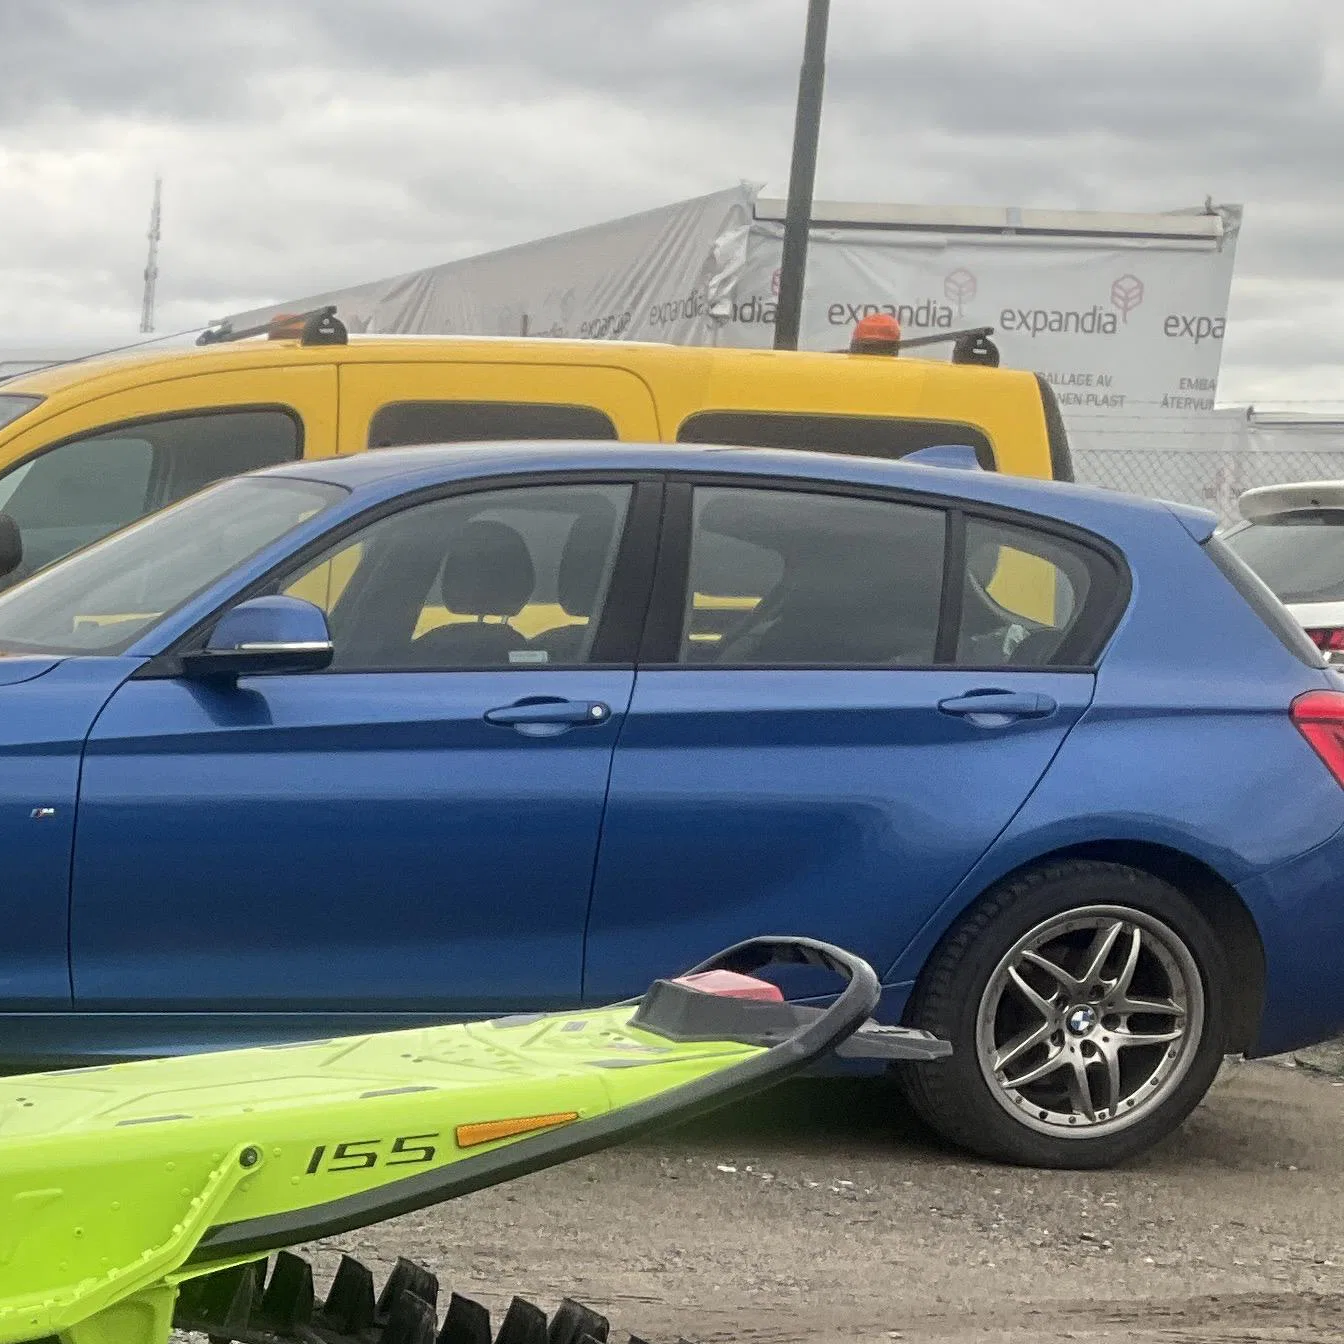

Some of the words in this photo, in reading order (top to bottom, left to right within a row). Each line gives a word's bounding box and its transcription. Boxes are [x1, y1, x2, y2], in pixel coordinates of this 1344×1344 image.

[1000, 305, 1118, 338] expandia
[1096, 373, 1113, 387] AV
[1086, 393, 1127, 409] PLAST
[305, 1132, 440, 1175] 155
